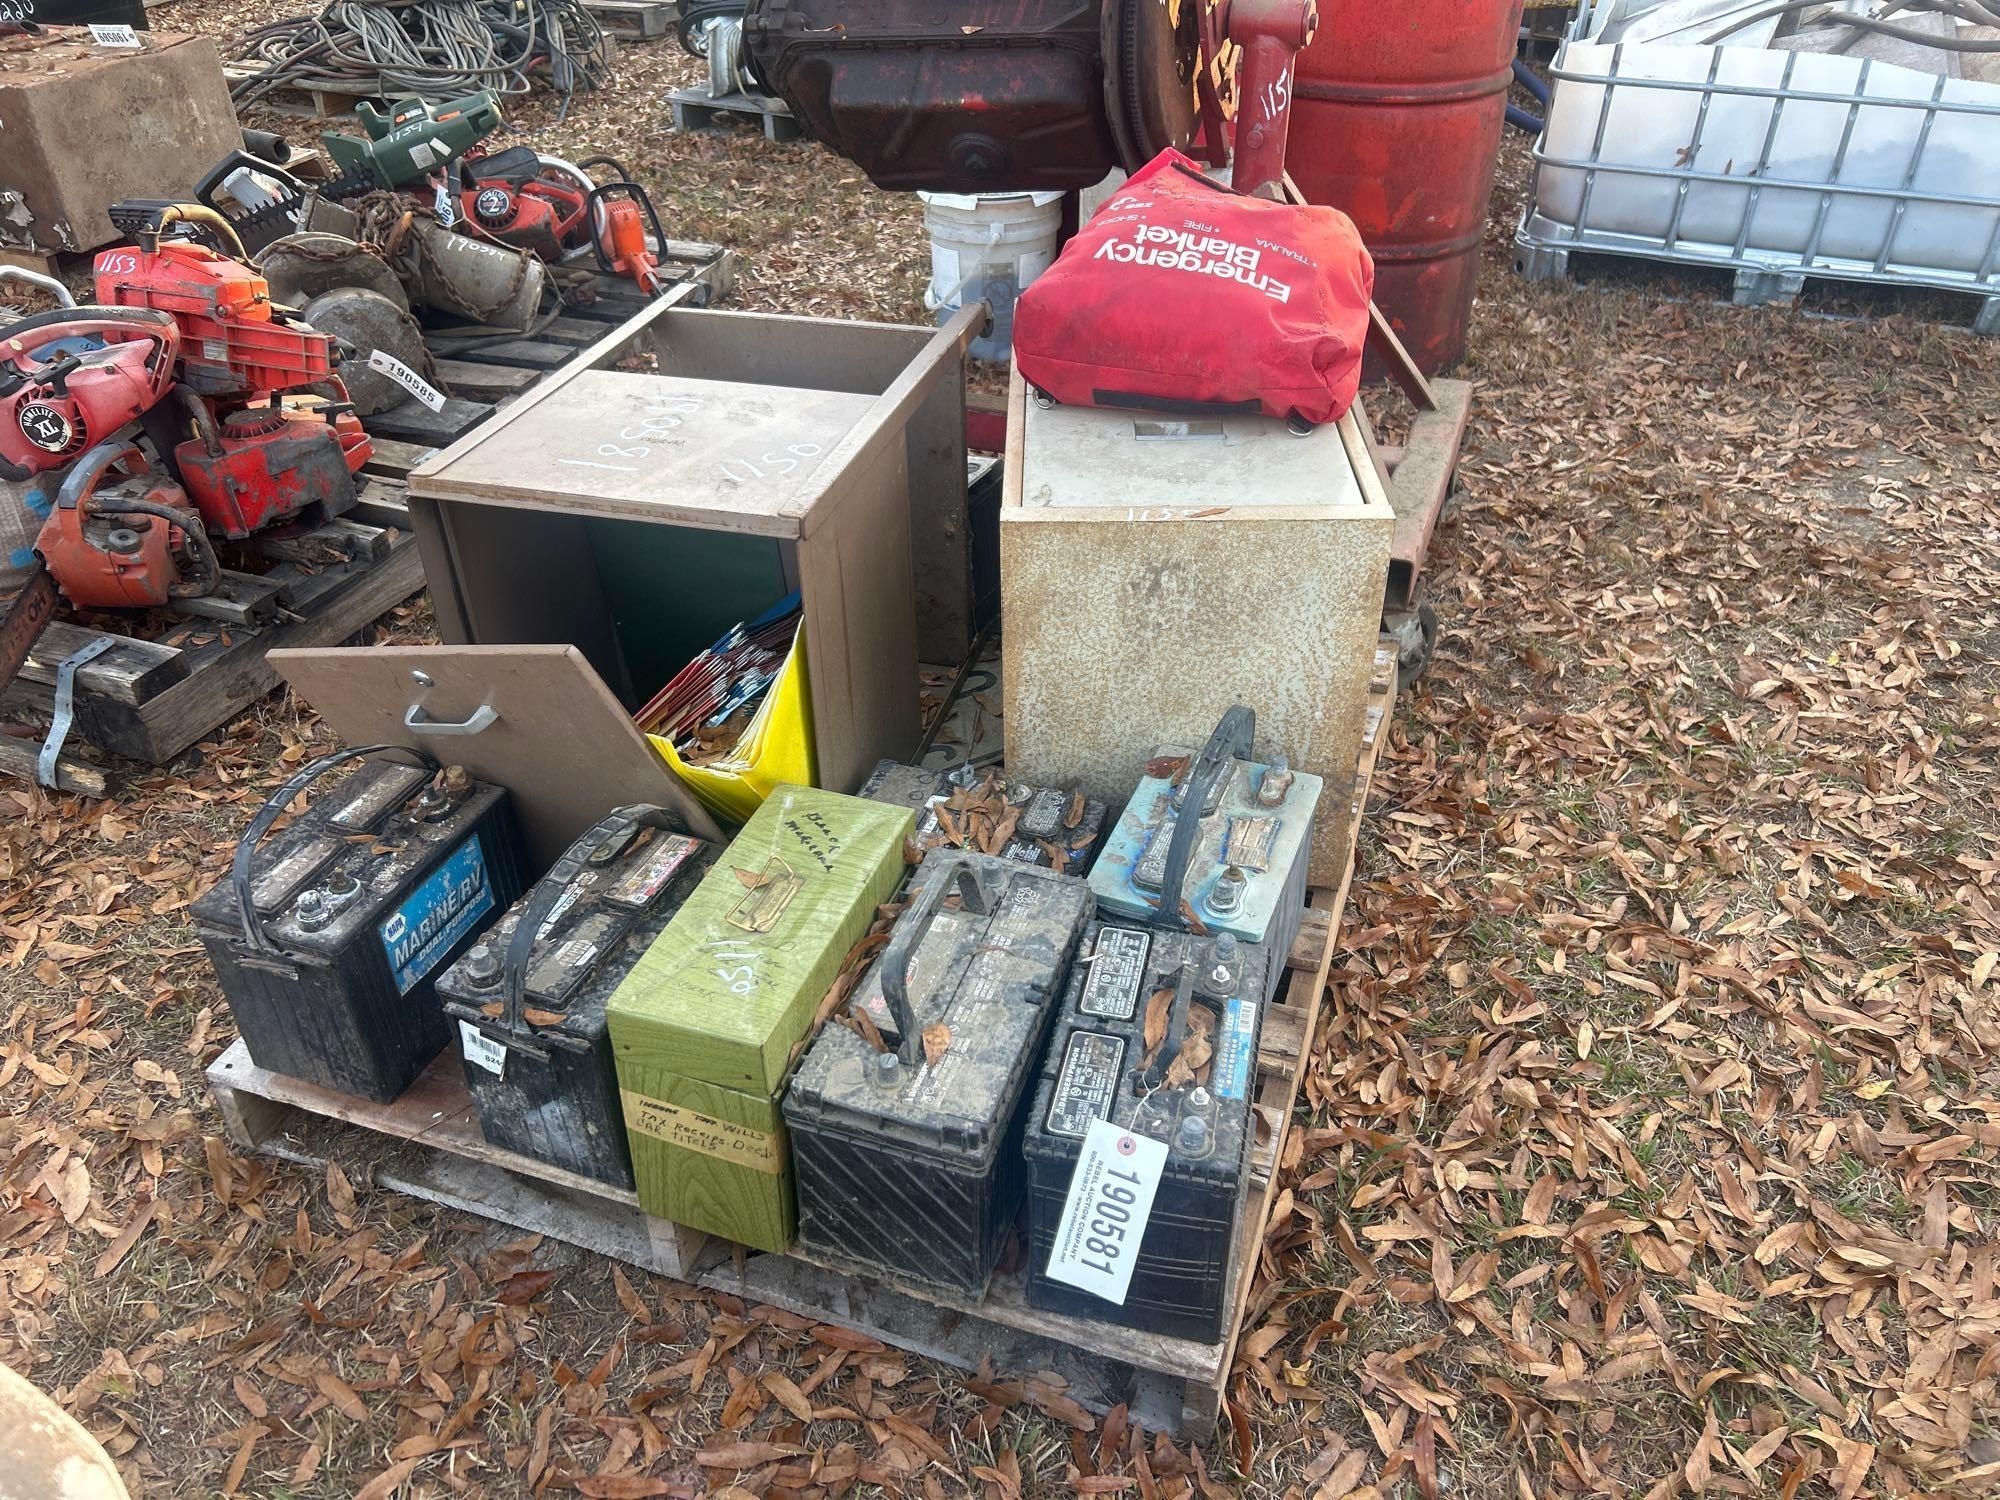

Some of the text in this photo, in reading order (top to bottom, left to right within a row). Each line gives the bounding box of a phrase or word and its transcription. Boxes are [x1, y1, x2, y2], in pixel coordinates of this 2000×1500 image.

[488, 196, 500, 212] 2
[1184, 219, 1213, 233] FIRE
[1132, 223, 1261, 272] Blanket
[1255, 237, 1311, 266] TRAUMA
[100, 253, 136, 274] 1153
[1093, 238, 1292, 304] Emergency
[389, 362, 436, 402] 190585
[23, 407, 55, 427] HOMELITE
[34, 419, 60, 438] XL
[387, 917, 404, 939] NAPA
[636, 1118, 662, 1136] CAR
[640, 1110, 667, 1127] TAX
[722, 1123, 766, 1141] WILLS
[1069, 1160, 1104, 1261] REBEL AUCTION COMPANY
[1081, 1169, 1142, 1275] 190581
